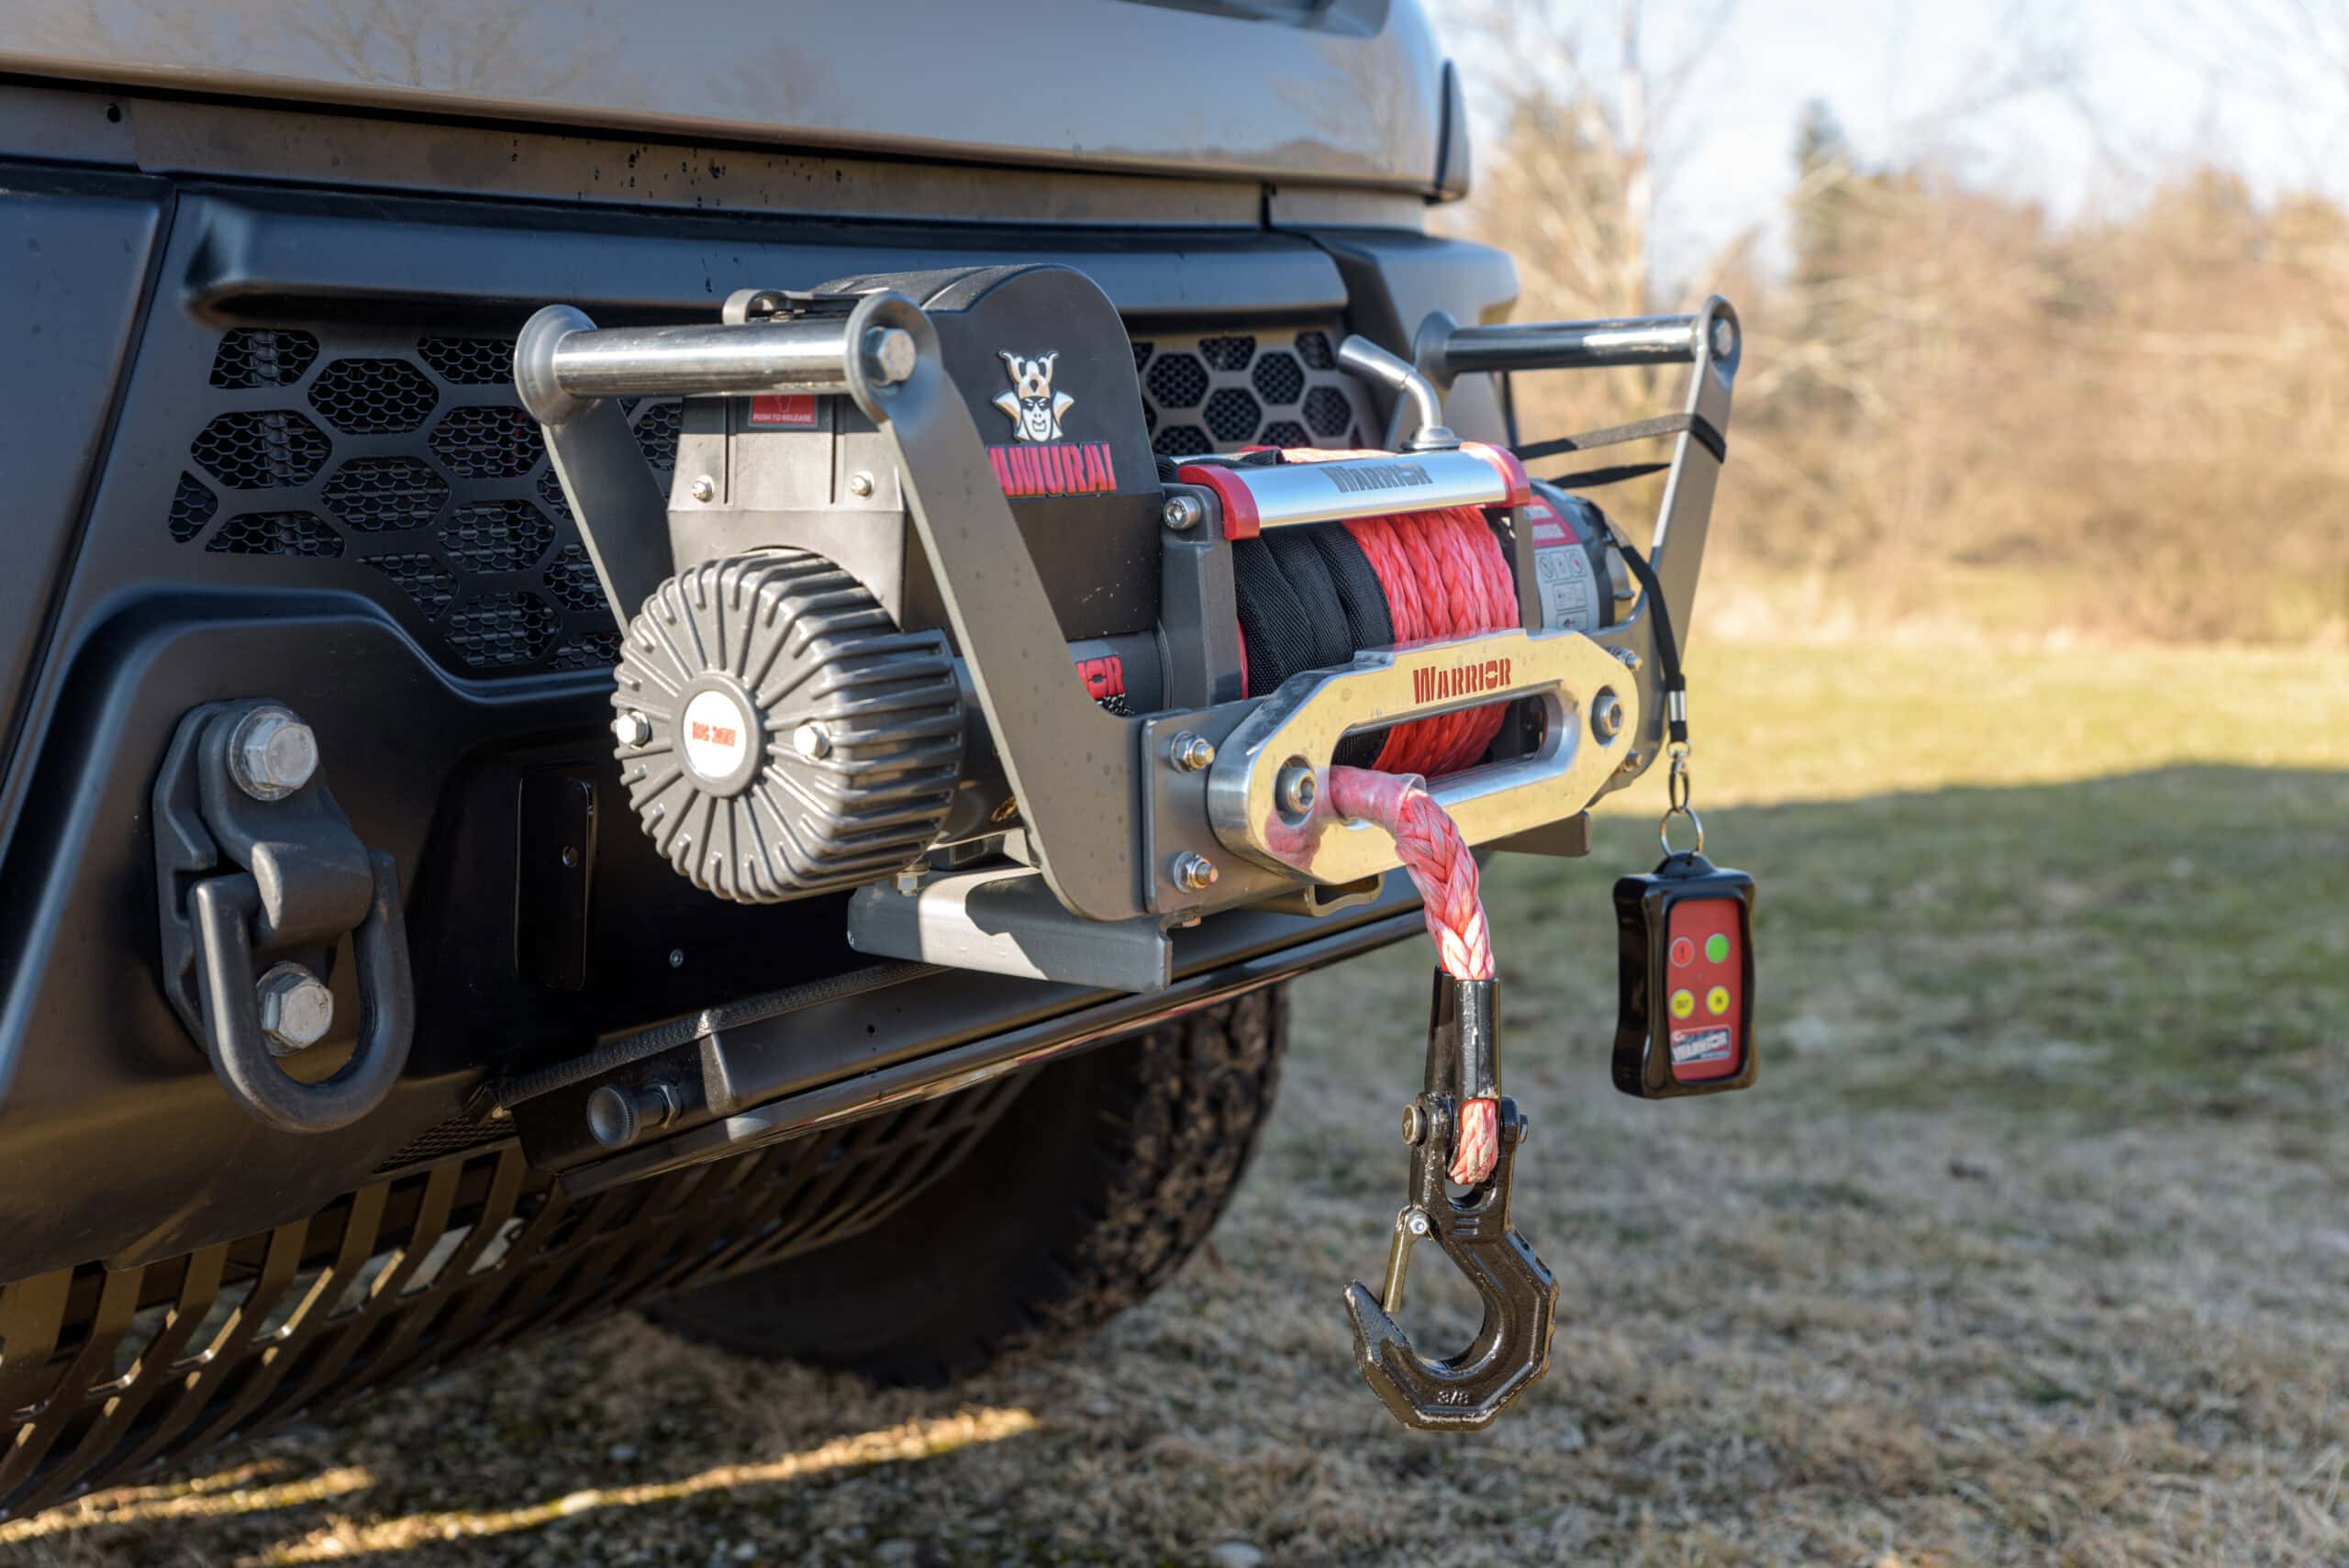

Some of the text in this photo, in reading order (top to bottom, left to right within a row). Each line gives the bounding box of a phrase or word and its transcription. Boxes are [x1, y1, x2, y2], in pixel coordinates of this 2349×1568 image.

[753, 413, 772, 422] PUSH
[783, 414, 812, 423] RELEASE
[988, 443, 1117, 496] AMURAI
[1319, 463, 1433, 493] WARRIOR
[1413, 658, 1511, 705] WARRIOR
